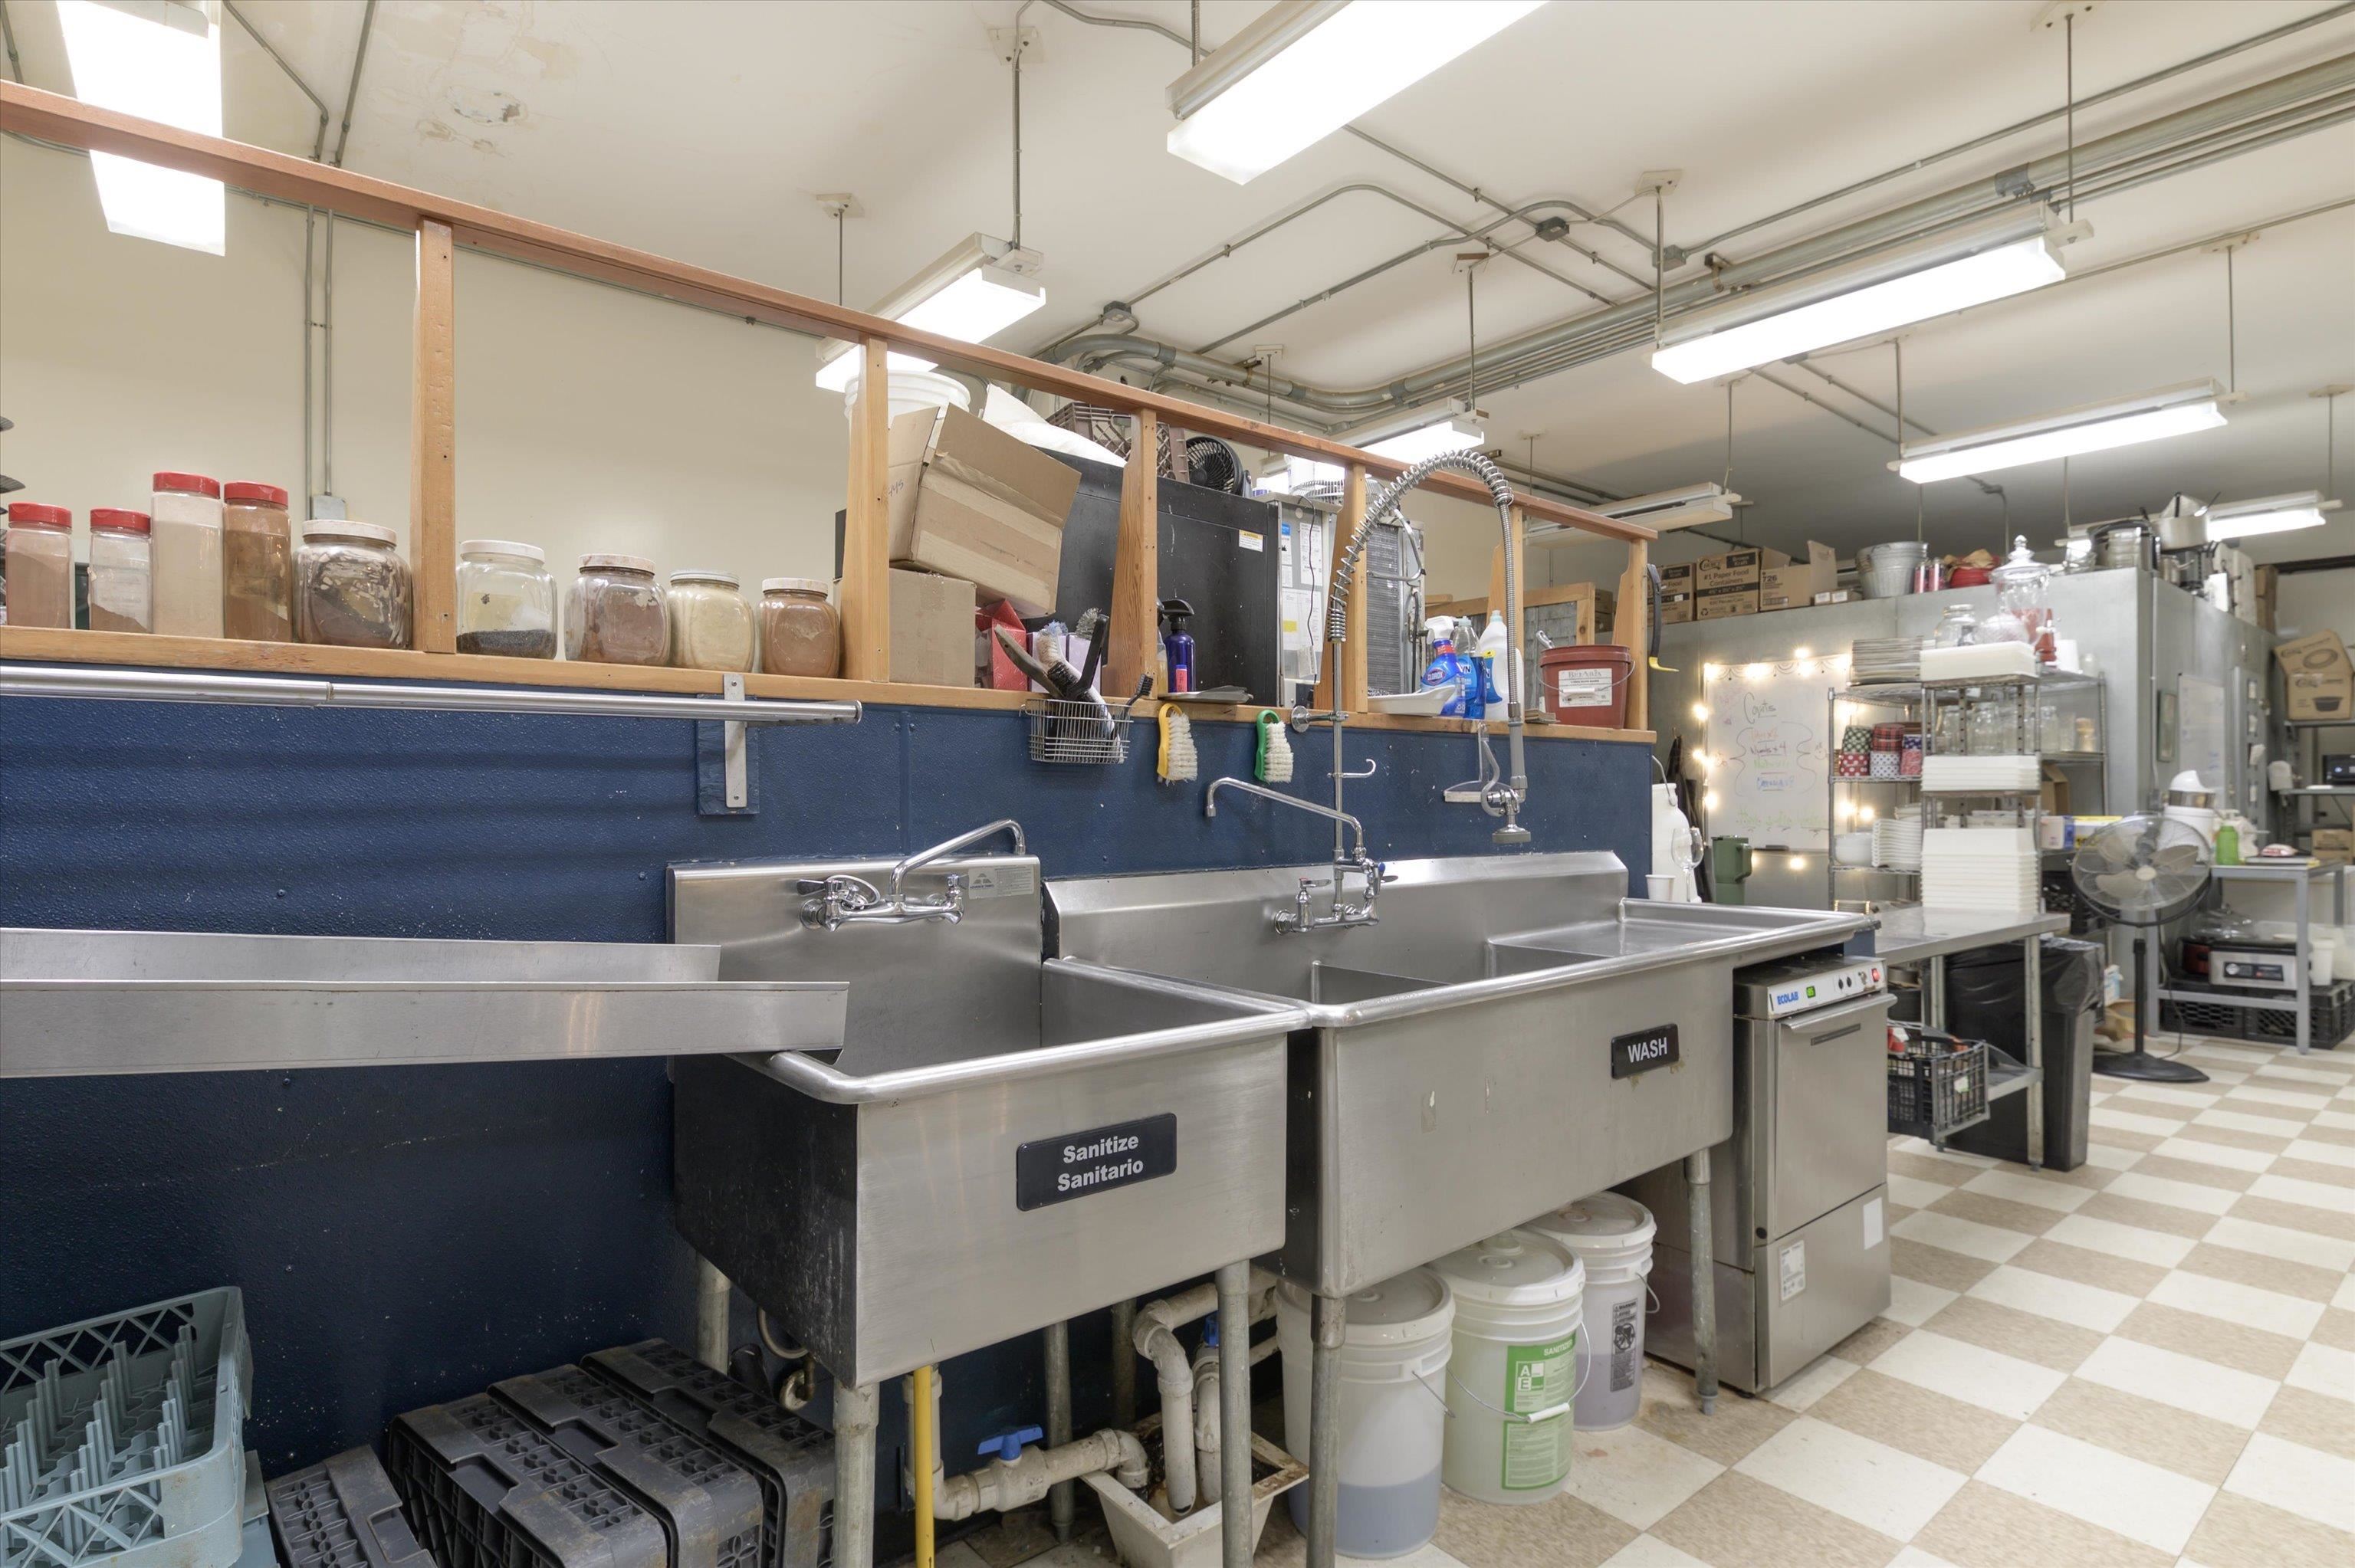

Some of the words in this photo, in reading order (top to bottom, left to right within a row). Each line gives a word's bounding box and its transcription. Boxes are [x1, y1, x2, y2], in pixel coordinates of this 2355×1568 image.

[1710, 578, 1744, 587] Containers
[1713, 572, 1732, 581] Paper
[1776, 991, 1800, 1005] ECOLAB
[1627, 1036, 1668, 1064] WASH
[1063, 1134, 1140, 1164] Sanitize
[1056, 1158, 1145, 1192] Sanitario
[1543, 1340, 1574, 1357] SANITIZER
[1519, 1364, 1531, 1377] A
[1520, 1379, 1530, 1390] E
